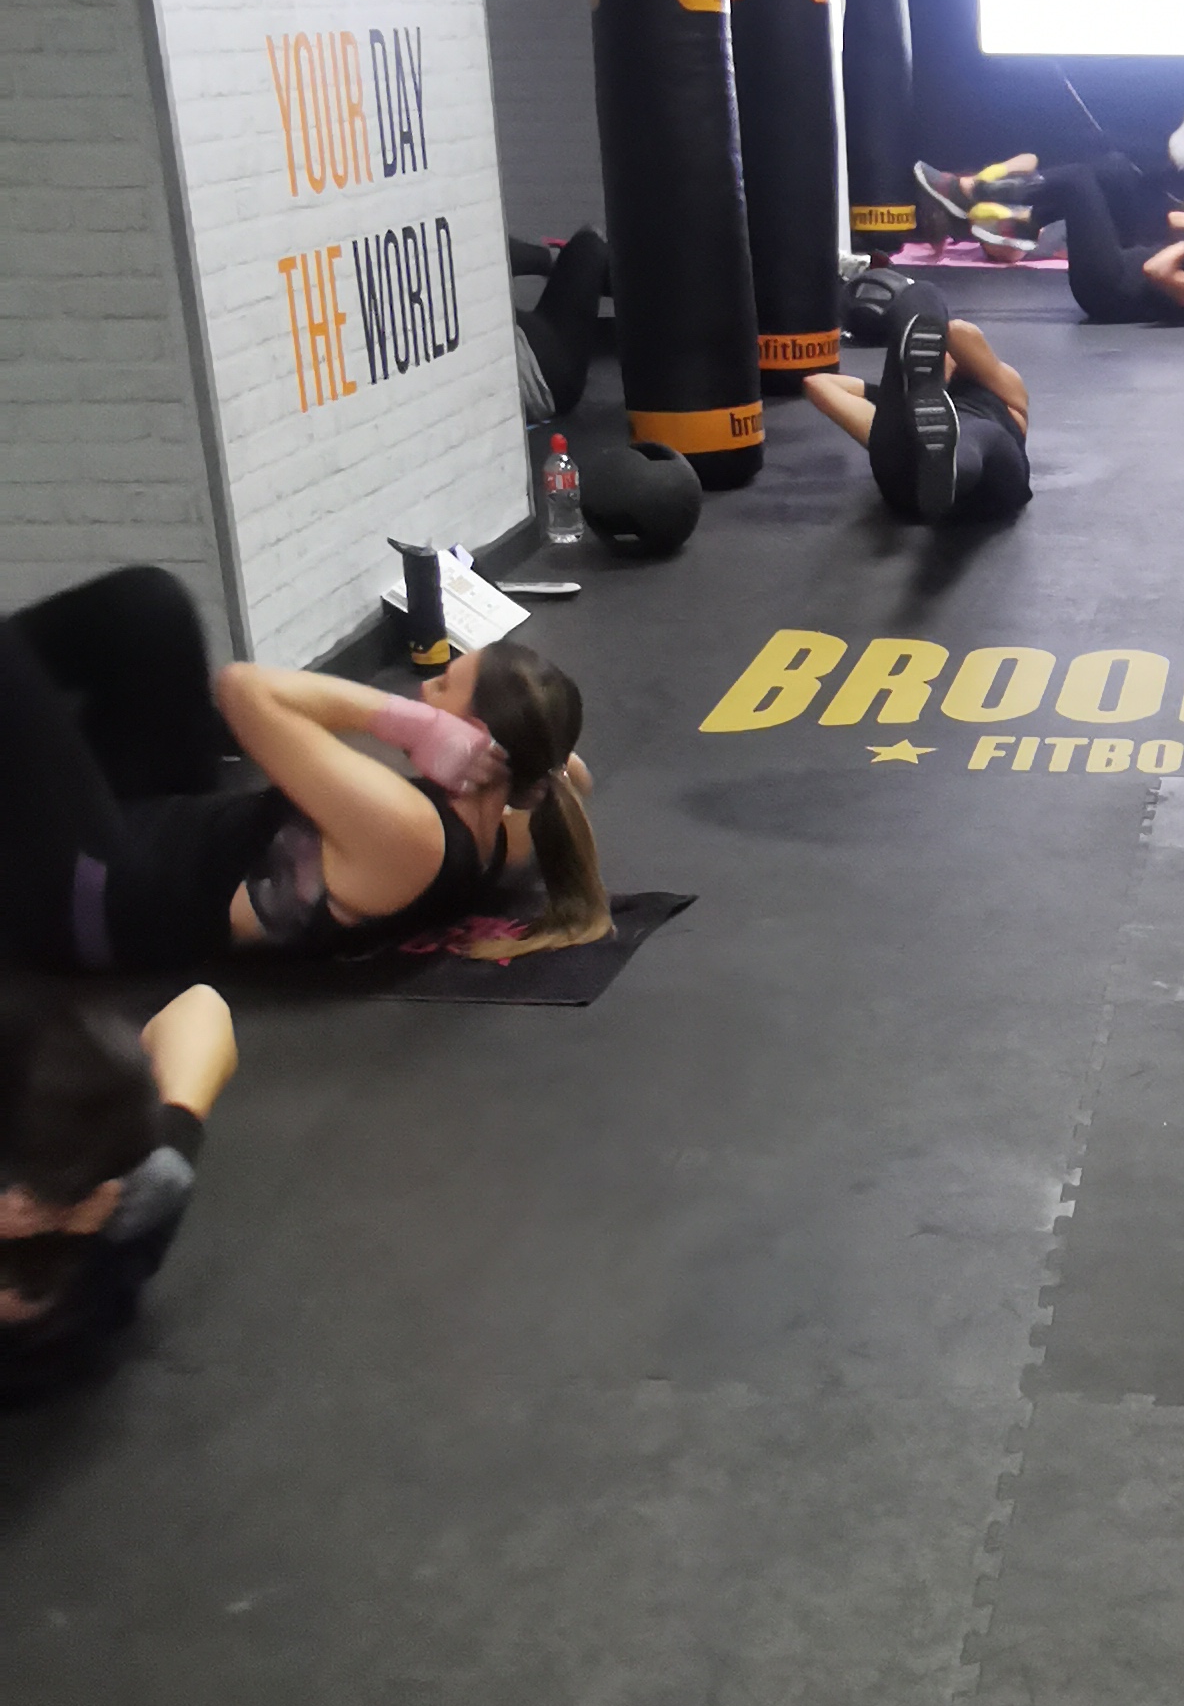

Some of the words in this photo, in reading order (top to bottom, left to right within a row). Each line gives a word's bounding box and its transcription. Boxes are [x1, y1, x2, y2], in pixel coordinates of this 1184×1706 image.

[266, 31, 374, 198] YOUR
[368, 26, 428, 179] DAY
[277, 245, 358, 413] THE
[352, 216, 461, 385] WORLD
